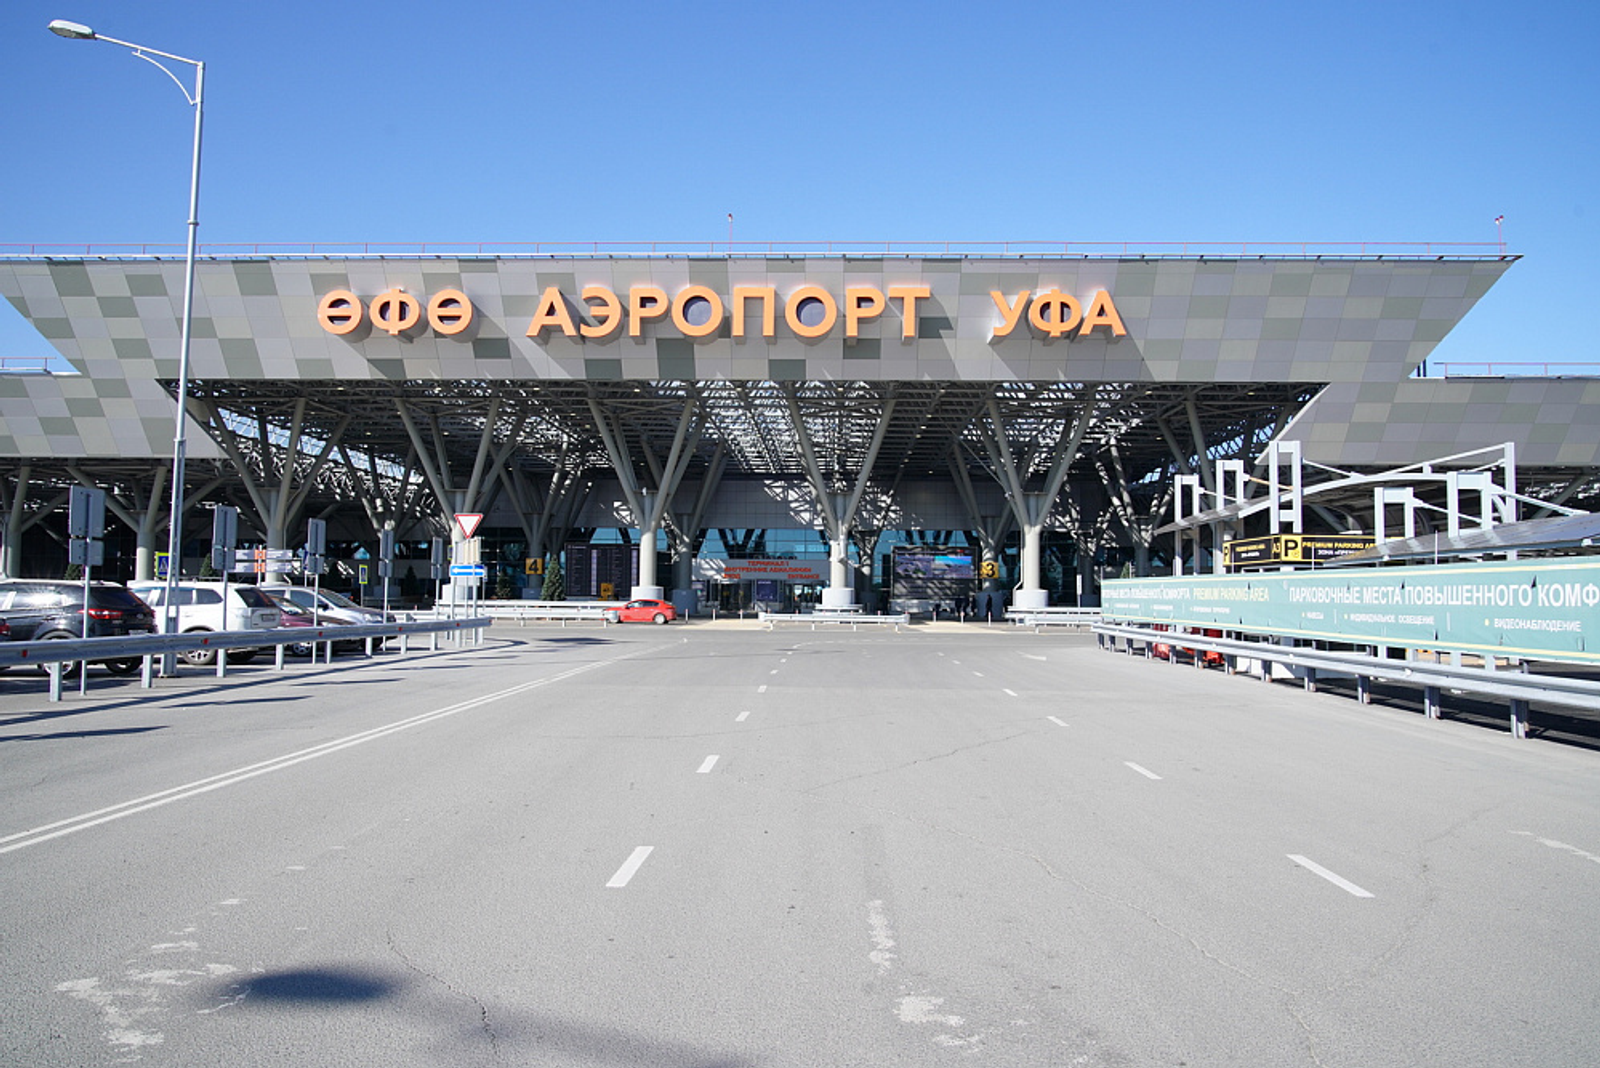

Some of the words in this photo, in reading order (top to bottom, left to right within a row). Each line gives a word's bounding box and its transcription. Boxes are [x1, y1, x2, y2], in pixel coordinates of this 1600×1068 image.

[317, 287, 473, 336] ӨФӨ
[525, 285, 931, 338] АЭРОПОРТ
[989, 287, 1127, 338] УФА
[1284, 539, 1298, 557] P
[1302, 541, 1333, 549] PREMIUM
[528, 559, 539, 573] 4
[985, 562, 996, 578] 3
[1249, 587, 1270, 602] AREA
[1289, 585, 1361, 604] ПАРКОВОЧНЫЕ
[1363, 586, 1402, 605] МЕСТА
[1405, 584, 1532, 607] ПОВЫШЕННОГО
[1538, 583, 1600, 607] КОМФ
[1494, 618, 1581, 633] ВИДЕОНАБЛЮДЕНИЕ
